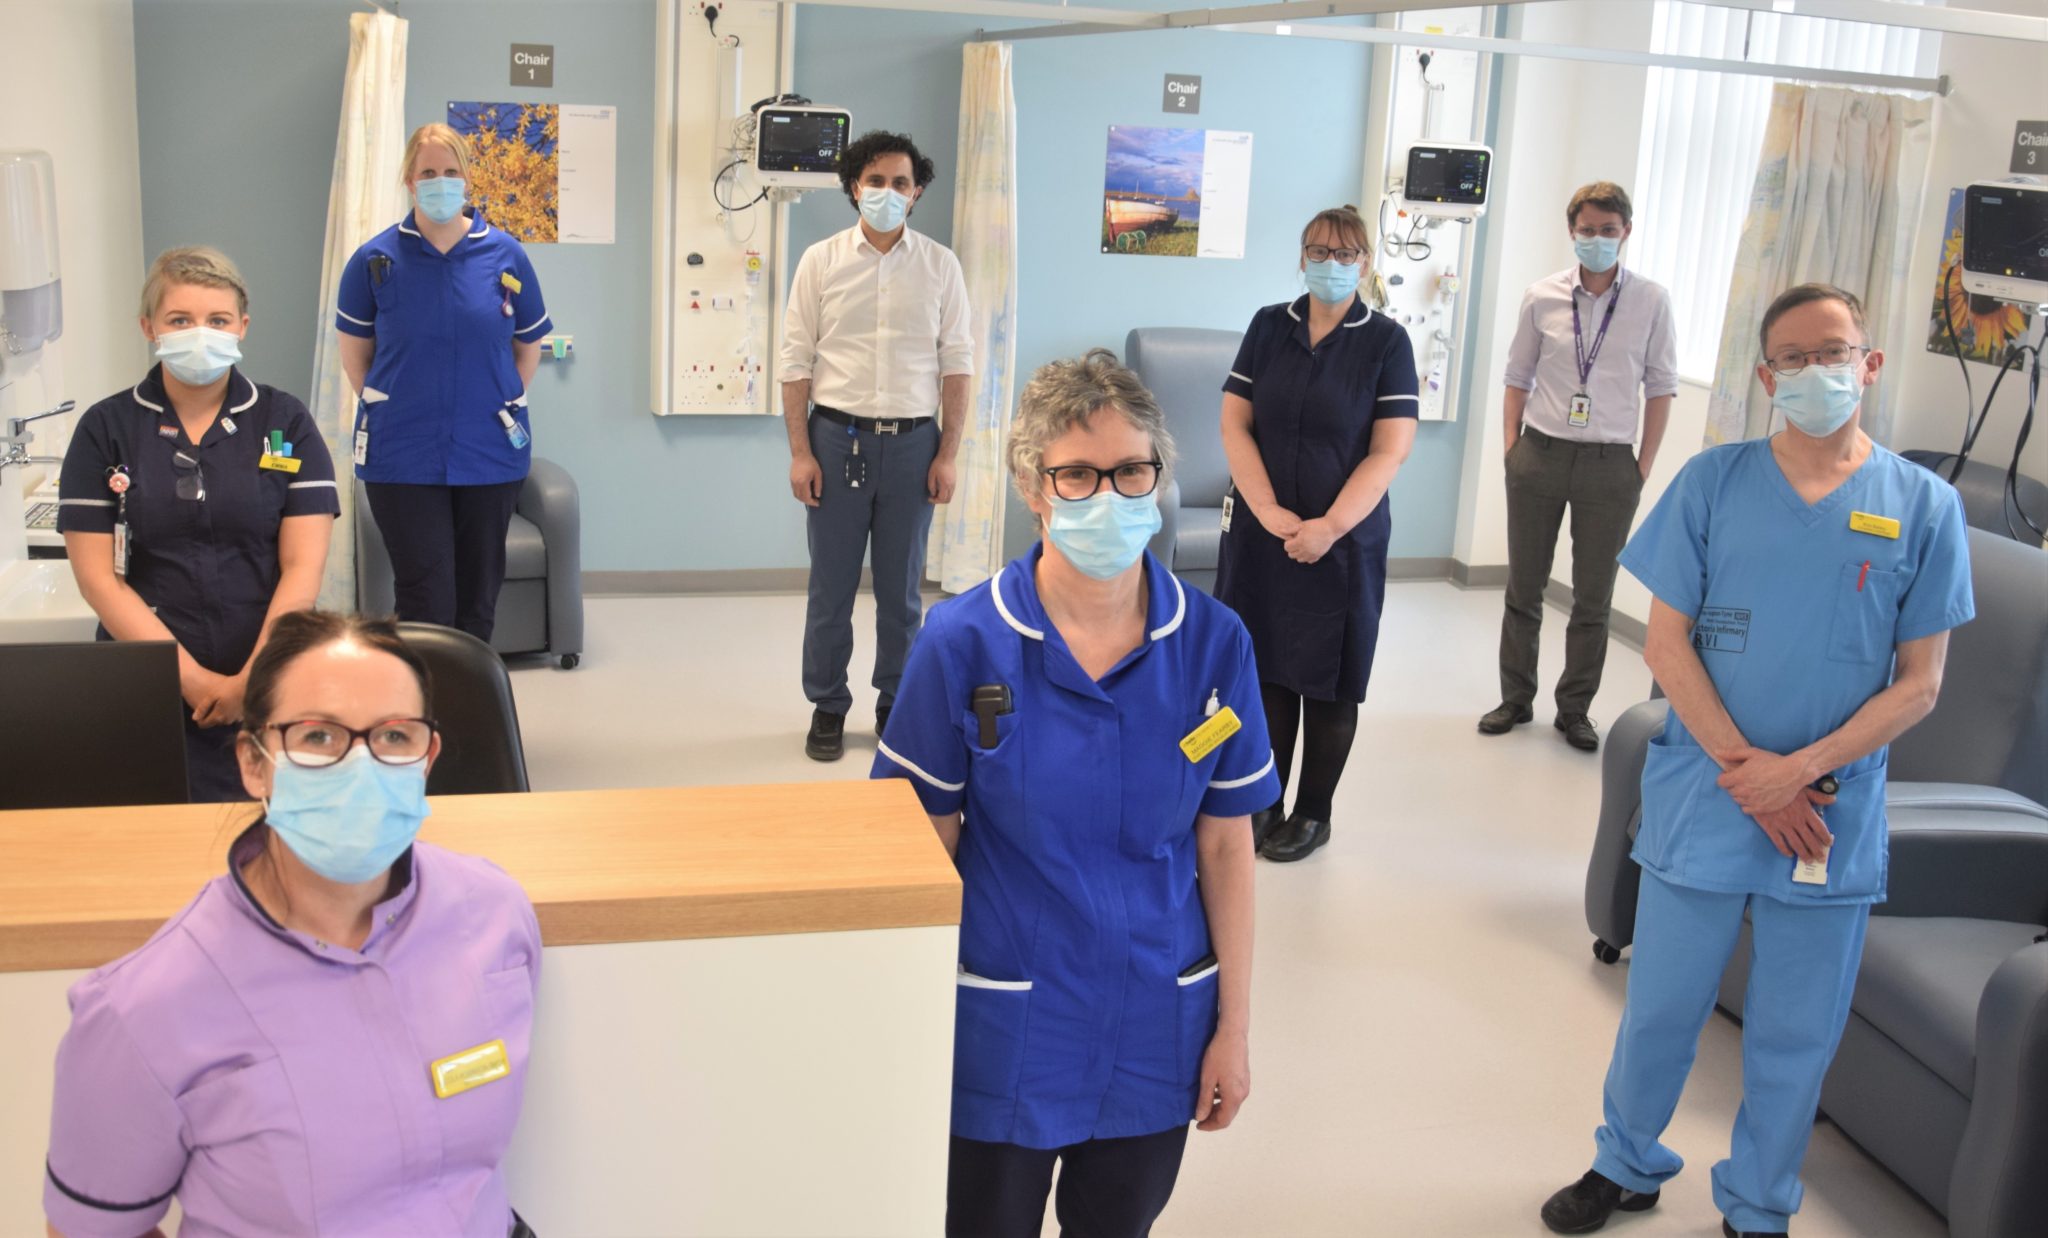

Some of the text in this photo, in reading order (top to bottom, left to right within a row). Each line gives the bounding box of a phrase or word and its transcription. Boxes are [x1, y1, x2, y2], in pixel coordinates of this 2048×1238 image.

[514, 52, 550, 66] Chair
[528, 68, 535, 80] 1
[1168, 81, 1198, 94] Chair
[1178, 96, 1186, 107] 2
[819, 149, 833, 157] OFF
[2027, 151, 2036, 165] 3
[1716, 625, 1745, 637] Infirmary
